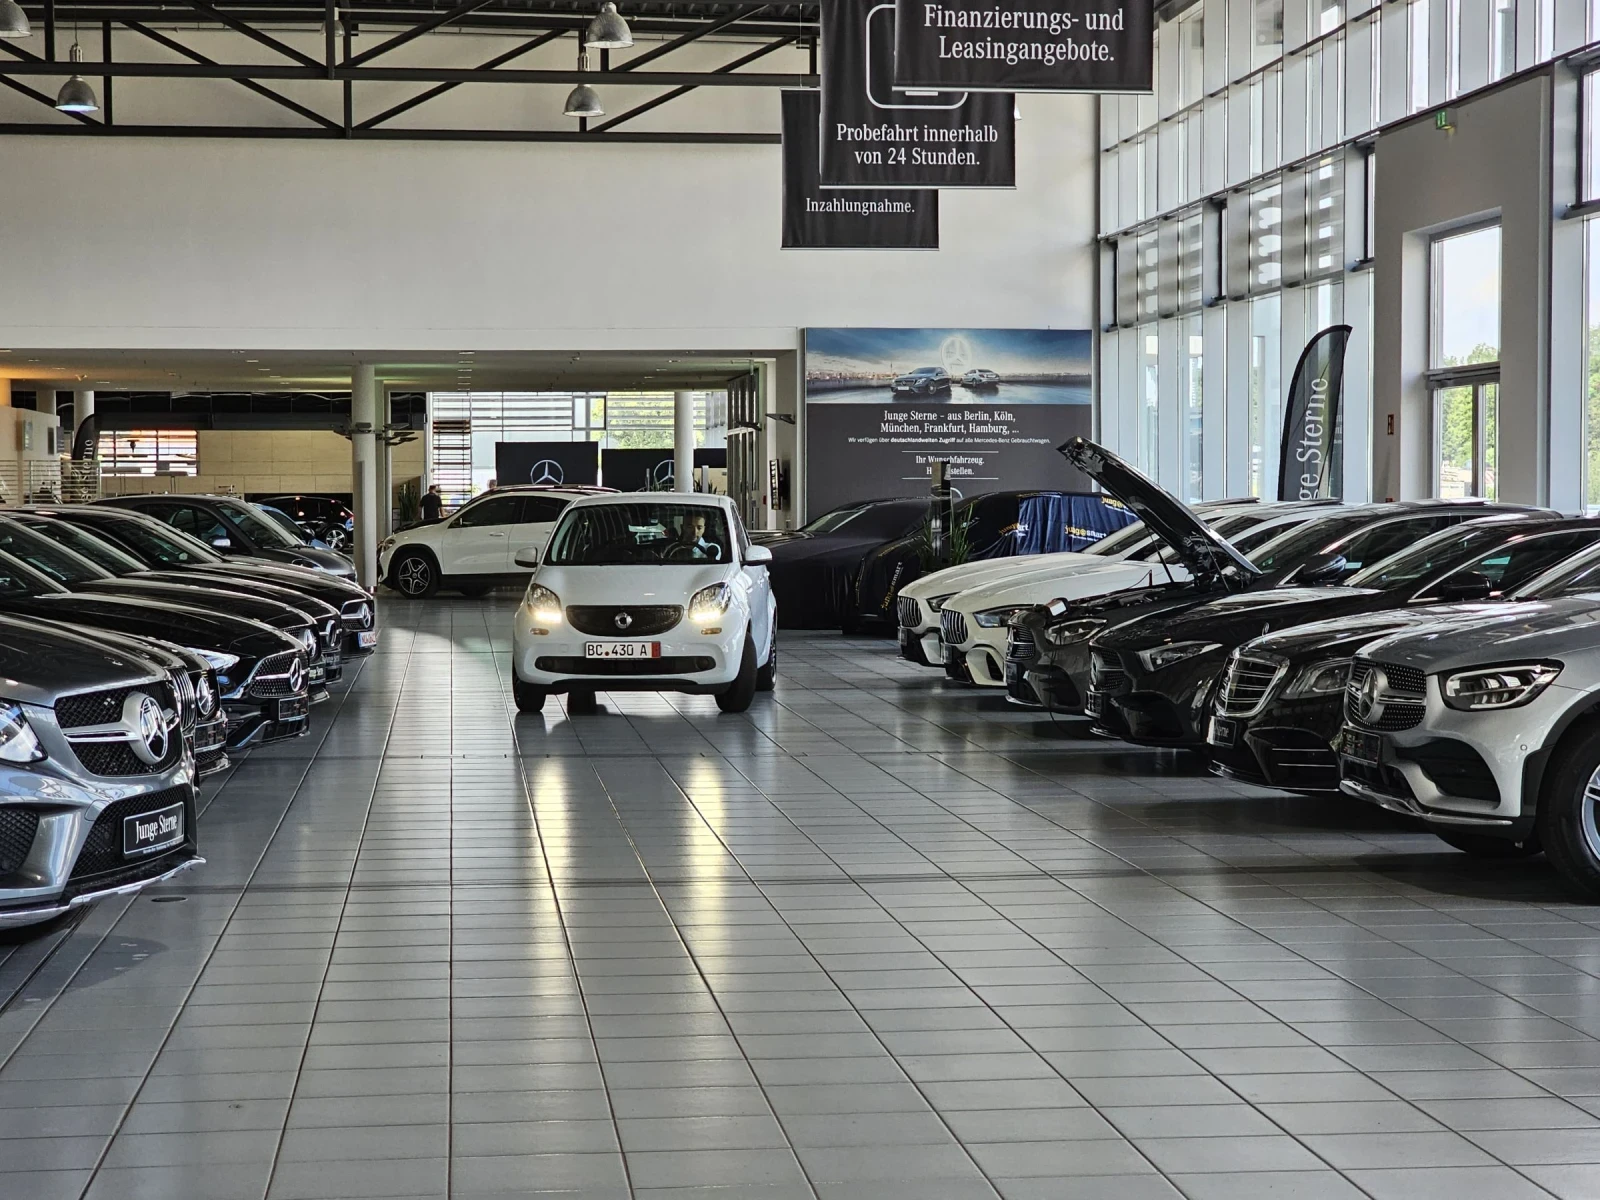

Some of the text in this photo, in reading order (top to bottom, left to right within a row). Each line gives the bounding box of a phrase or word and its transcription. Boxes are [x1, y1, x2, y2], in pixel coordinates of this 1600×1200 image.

[924, 4, 1124, 35] Finanzierungs- und
[938, 35, 1115, 66] Leasingangebote.
[837, 123, 998, 143] Probefahrt innerhalb
[855, 148, 980, 166] von 24 Stunden.
[806, 197, 915, 216] Inzahlungnahme.
[884, 410, 908, 422] Junge
[910, 410, 938, 420] Sterne
[947, 412, 961, 421] aus
[964, 410, 992, 422] Berlin,
[994, 411, 1016, 422] Köln,
[880, 422, 922, 434] München,
[924, 422, 967, 434] Frankfurt,
[969, 423, 1010, 435] Hamburg,
[916, 455, 926, 464] Ihr
[950, 466, 975, 475] stellen.
[587, 644, 648, 656] BC 430 A
[135, 814, 178, 845] Junge Sterne
